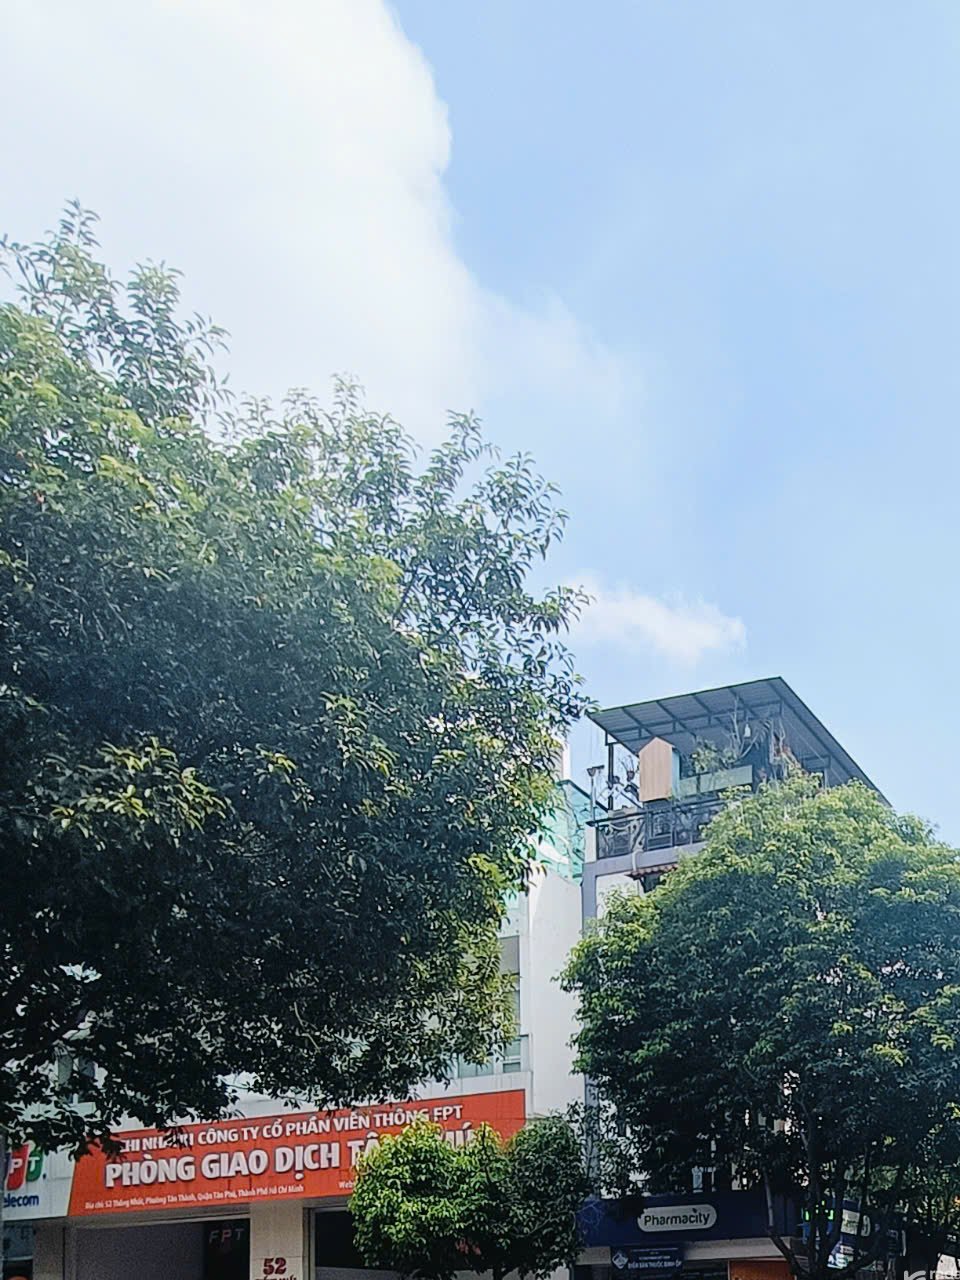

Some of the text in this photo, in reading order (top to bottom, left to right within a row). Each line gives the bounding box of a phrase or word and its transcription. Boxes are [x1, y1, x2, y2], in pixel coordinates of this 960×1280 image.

[120, 1137, 140, 1152] HI
[198, 1127, 239, 1144] CÔNG
[242, 1124, 260, 1141] TY
[374, 1107, 430, 1127] THÔNG
[433, 1104, 464, 1122] FPT
[105, 1153, 196, 1188] PHÒNG
[201, 1147, 271, 1179] GIAO
[275, 1142, 341, 1180] DỊCH
[644, 1211, 711, 1226] Pharmacity
[263, 1257, 287, 1275] 52
